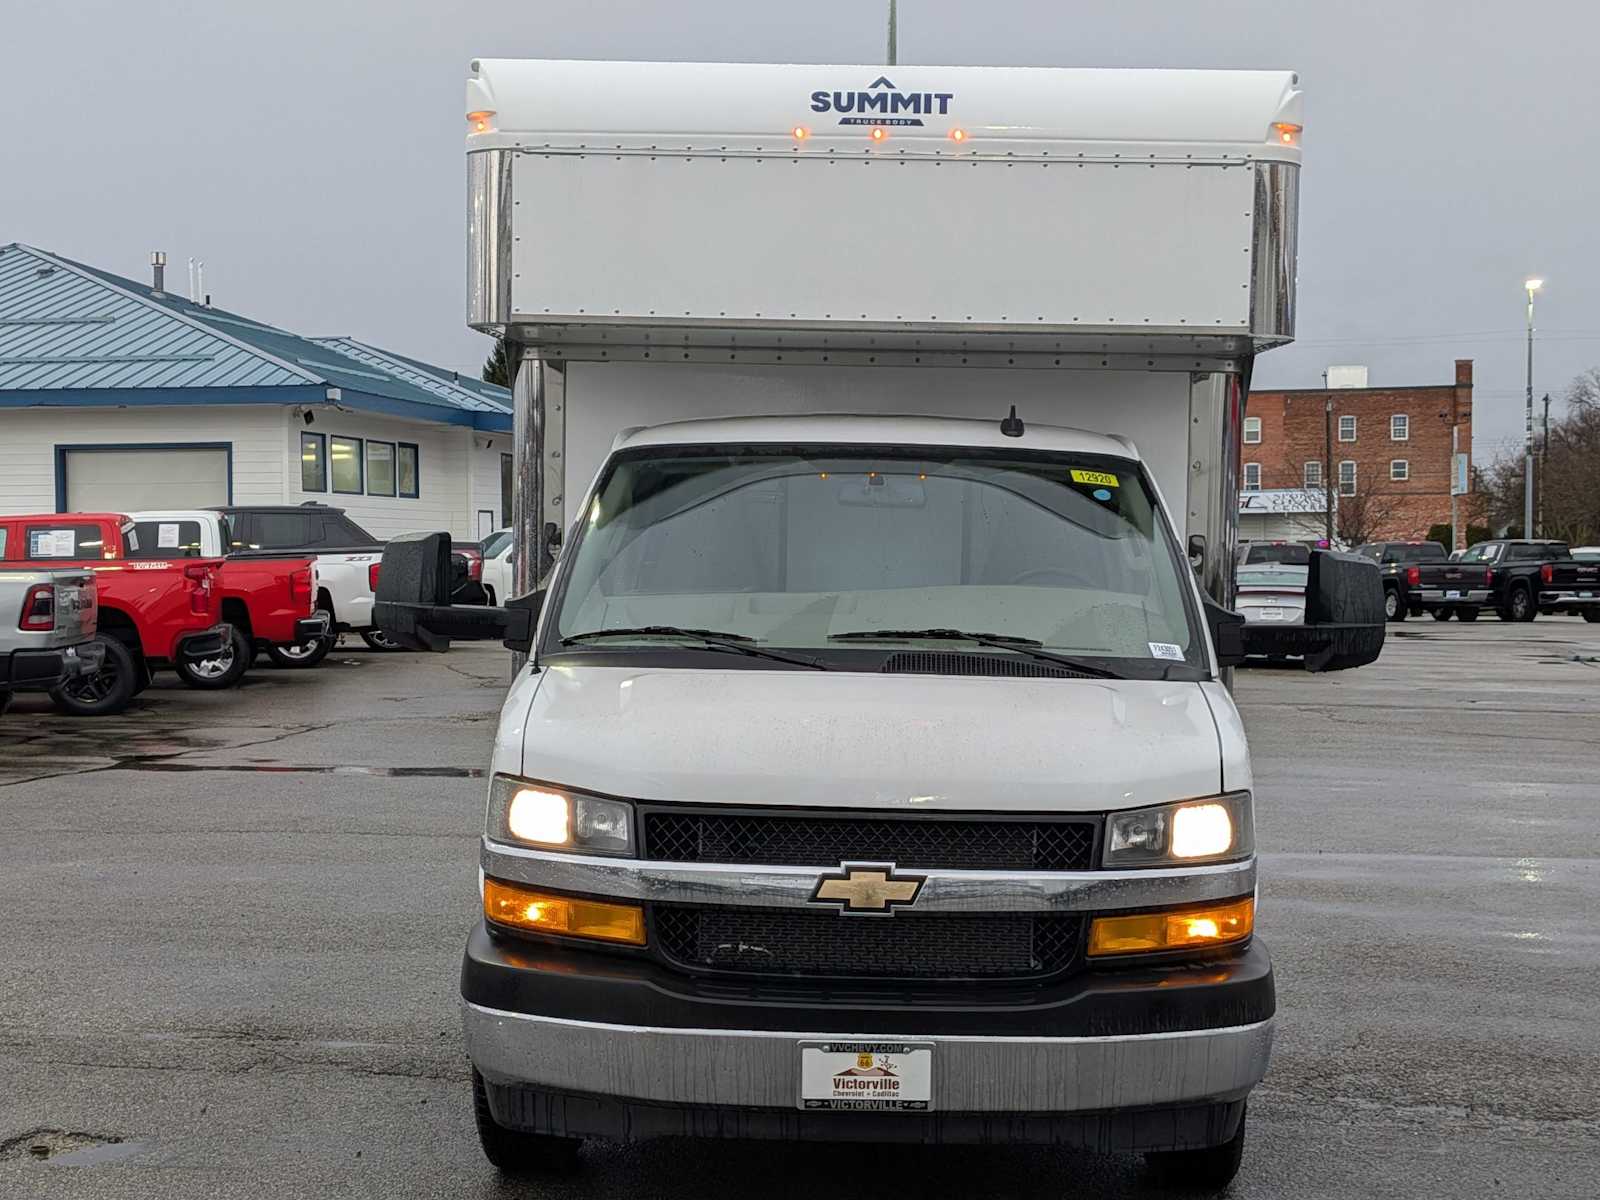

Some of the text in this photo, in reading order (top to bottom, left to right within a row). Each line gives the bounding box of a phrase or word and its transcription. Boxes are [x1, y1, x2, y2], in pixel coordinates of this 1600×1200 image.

[810, 91, 954, 115] SUMMIT
[1079, 471, 1112, 484] 12920
[831, 1043, 903, 1053] VVCHEVY.COM
[832, 1077, 900, 1090] Victorville
[832, 1090, 900, 1098] Chevrolet Cadillac
[829, 1100, 904, 1111] VICTORVILLE
